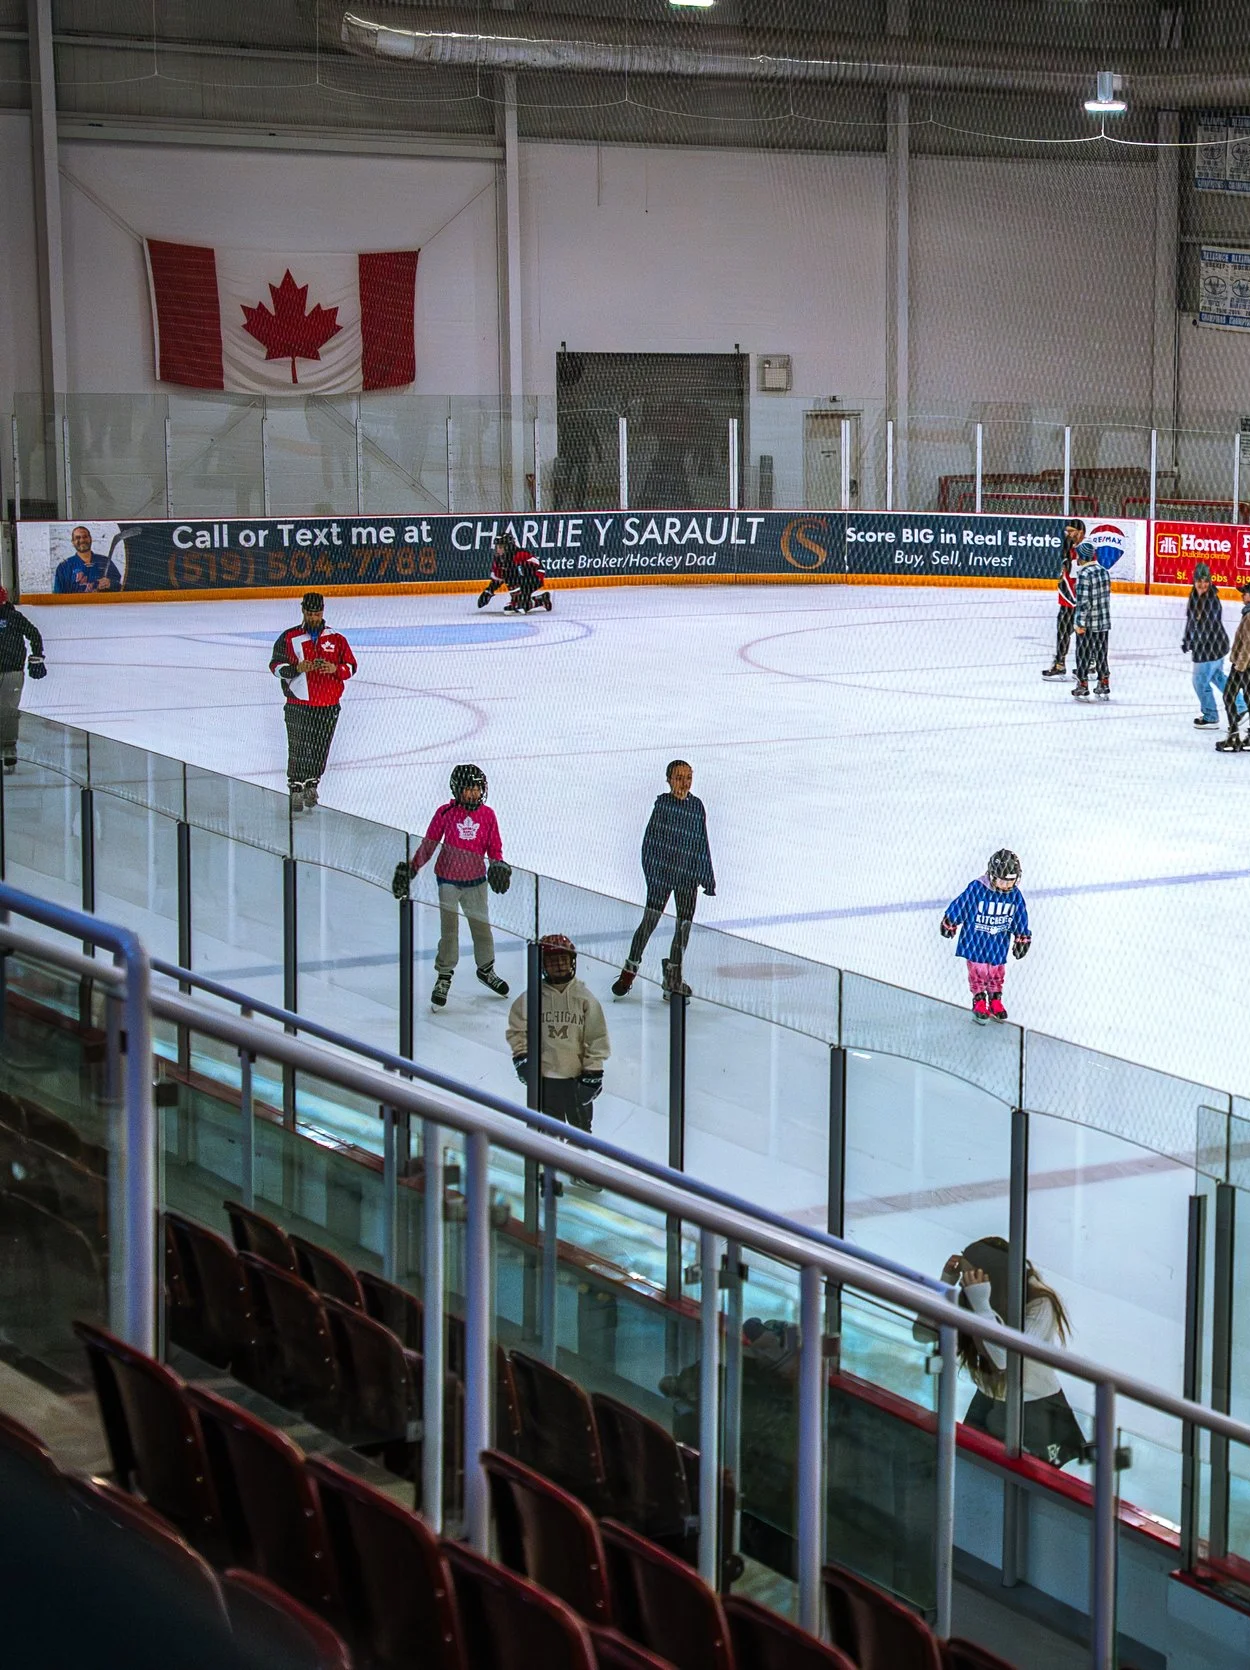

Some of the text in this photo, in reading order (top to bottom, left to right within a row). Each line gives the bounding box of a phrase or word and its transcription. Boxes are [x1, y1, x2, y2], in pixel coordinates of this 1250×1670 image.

[173, 521, 432, 549] Call or Text me at
[451, 517, 765, 551] CHARLIE Y SARAULT
[846, 527, 1061, 548] Score BIG in Real Estate
[1181, 534, 1231, 553] Home
[169, 547, 437, 587] (519) 504-7788
[541, 552, 716, 571] state Broker/Hockey Dad
[895, 550, 1013, 567] Buy, Sell, Invest
[1176, 571, 1188, 581] St.
[541, 1010, 586, 1025] ICHIGAN
[548, 1025, 568, 1039] M
